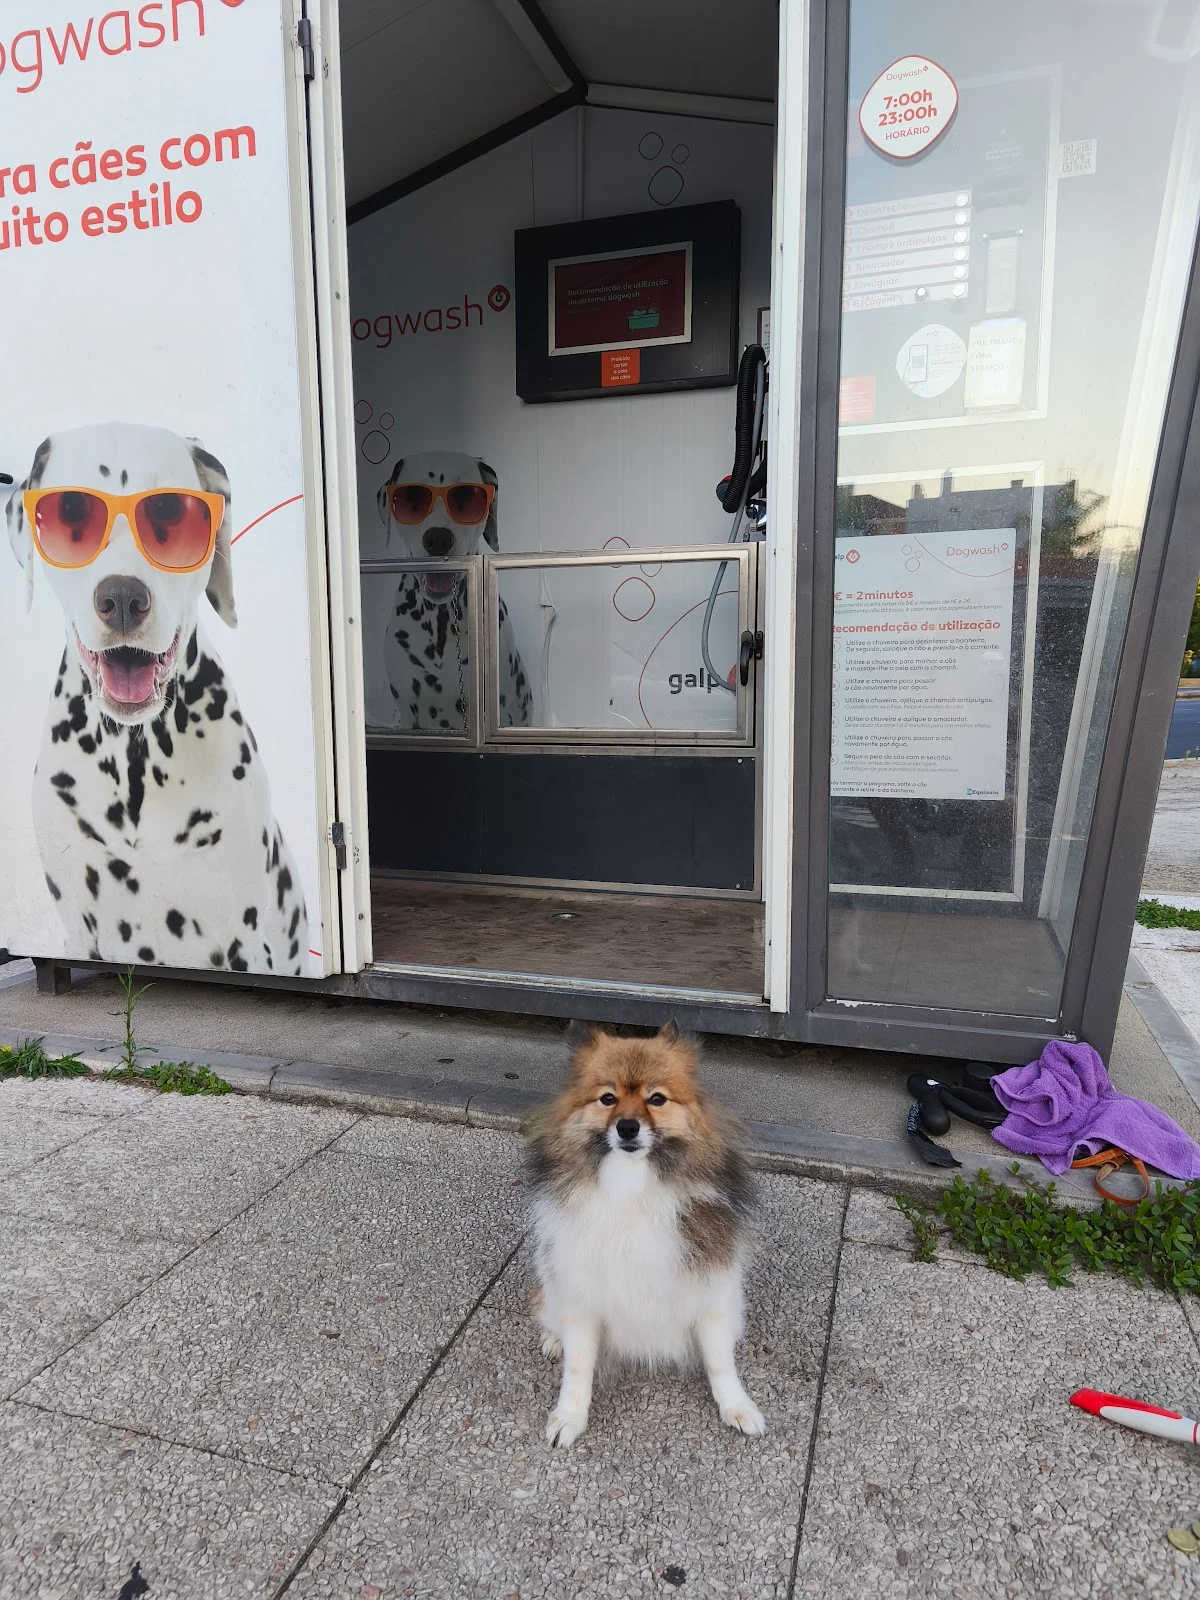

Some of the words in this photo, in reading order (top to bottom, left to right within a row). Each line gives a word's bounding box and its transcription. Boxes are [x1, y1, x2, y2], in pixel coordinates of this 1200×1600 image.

[0, 0, 206, 94] gwash
[886, 68, 922, 80] Dogwash
[884, 89, 932, 109] 7:00h
[878, 105, 938, 127] 23:00h
[885, 125, 930, 140] HORÁRIO
[49, 140, 147, 189] cães
[160, 125, 257, 170] com
[81, 181, 203, 237] estilo
[568, 284, 620, 296] Recomendação
[634, 278, 669, 289] utilização
[854, 278, 898, 290] Enxaguar
[578, 296, 606, 304] sistema
[608, 290, 640, 302] dogwash
[946, 544, 1000, 558] Dogwash
[920, 620, 936, 631] de
[938, 620, 1001, 632] utilização
[668, 667, 720, 695] galp
